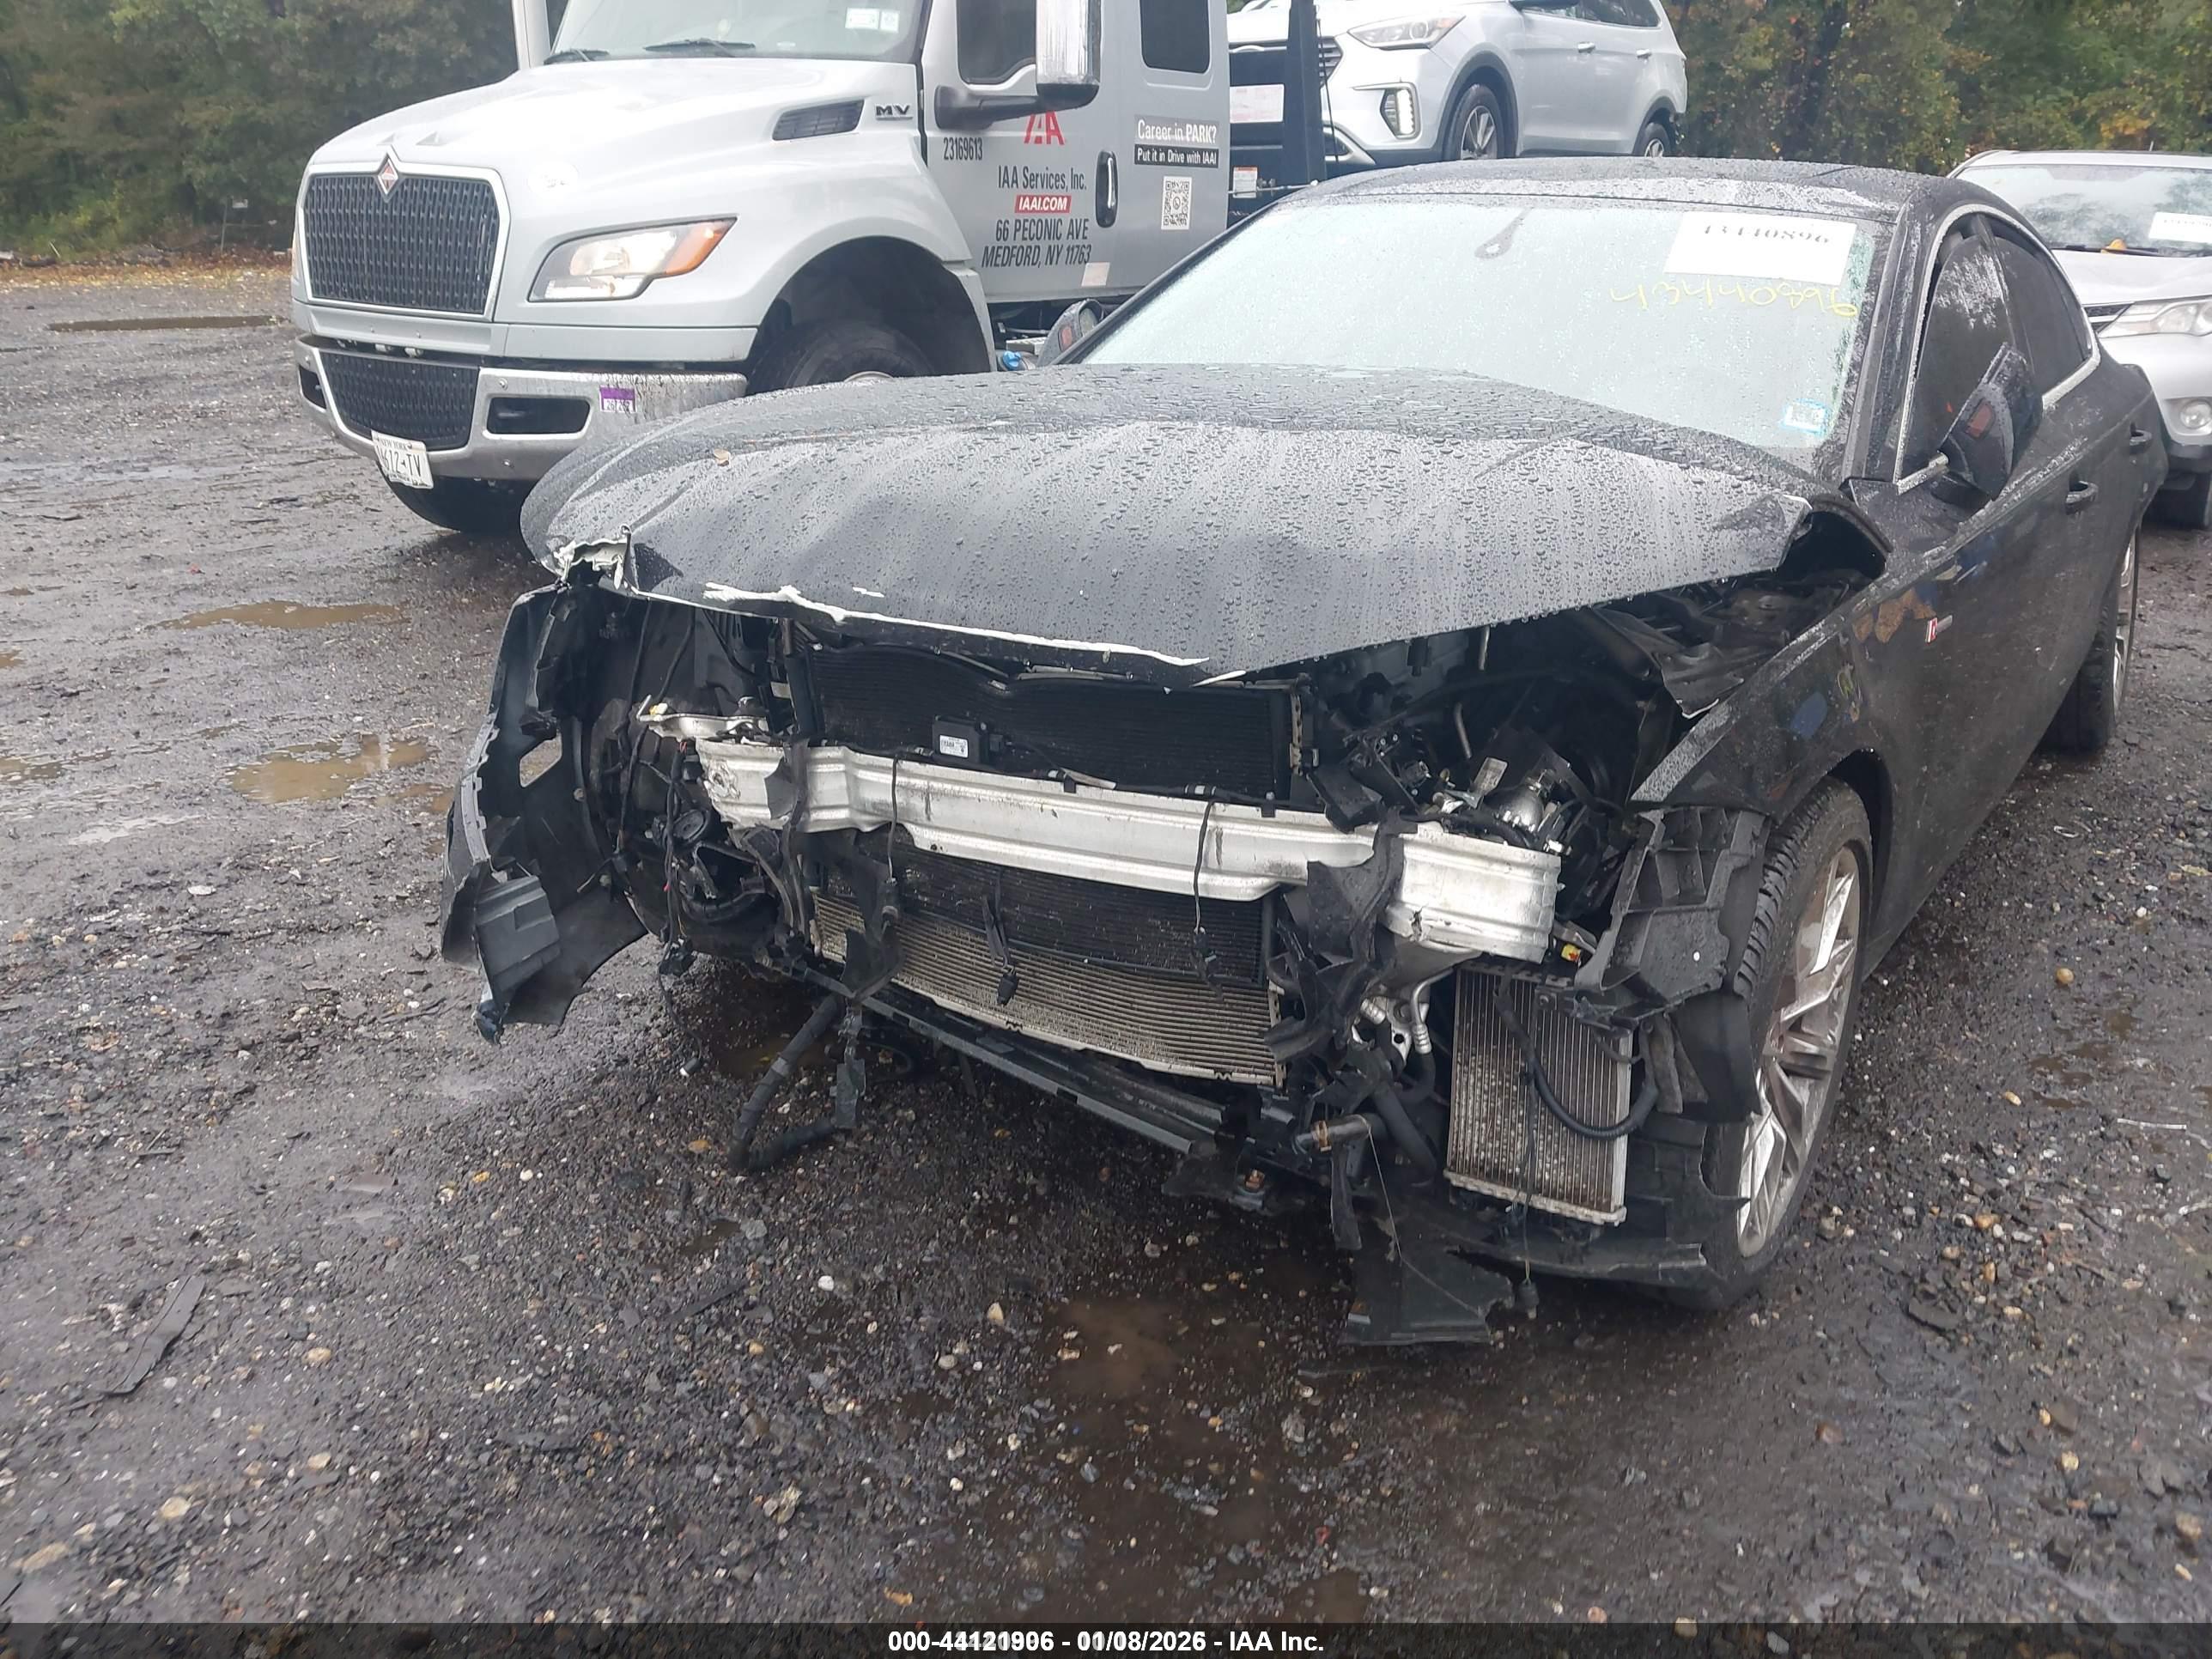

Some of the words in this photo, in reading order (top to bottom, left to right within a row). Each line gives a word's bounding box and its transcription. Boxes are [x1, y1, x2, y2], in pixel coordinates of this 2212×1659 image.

[876, 104, 910, 116] MV
[1138, 119, 1172, 141] Career
[1174, 122, 1184, 141] in
[1186, 123, 1217, 144] PARK?
[943, 137, 983, 161] 23169613
[1137, 148, 1151, 161] Put
[1152, 148, 1158, 162] it
[1159, 148, 1165, 162] in
[1168, 149, 1185, 163] Drive
[1186, 151, 1200, 164] with
[1202, 151, 1217, 165] IAAI
[998, 165, 1019, 189] IAA
[1023, 166, 1068, 192] Services,
[1071, 167, 1087, 190] Inc.
[1018, 196, 1068, 211] IAAI.COM
[996, 219, 1010, 241] 66
[1013, 218, 1063, 241] PECONIC
[1066, 218, 1090, 240] AVE
[981, 245, 1042, 269] MEDFORD,
[1045, 244, 1064, 266] NY
[1065, 244, 1092, 264] 11763
